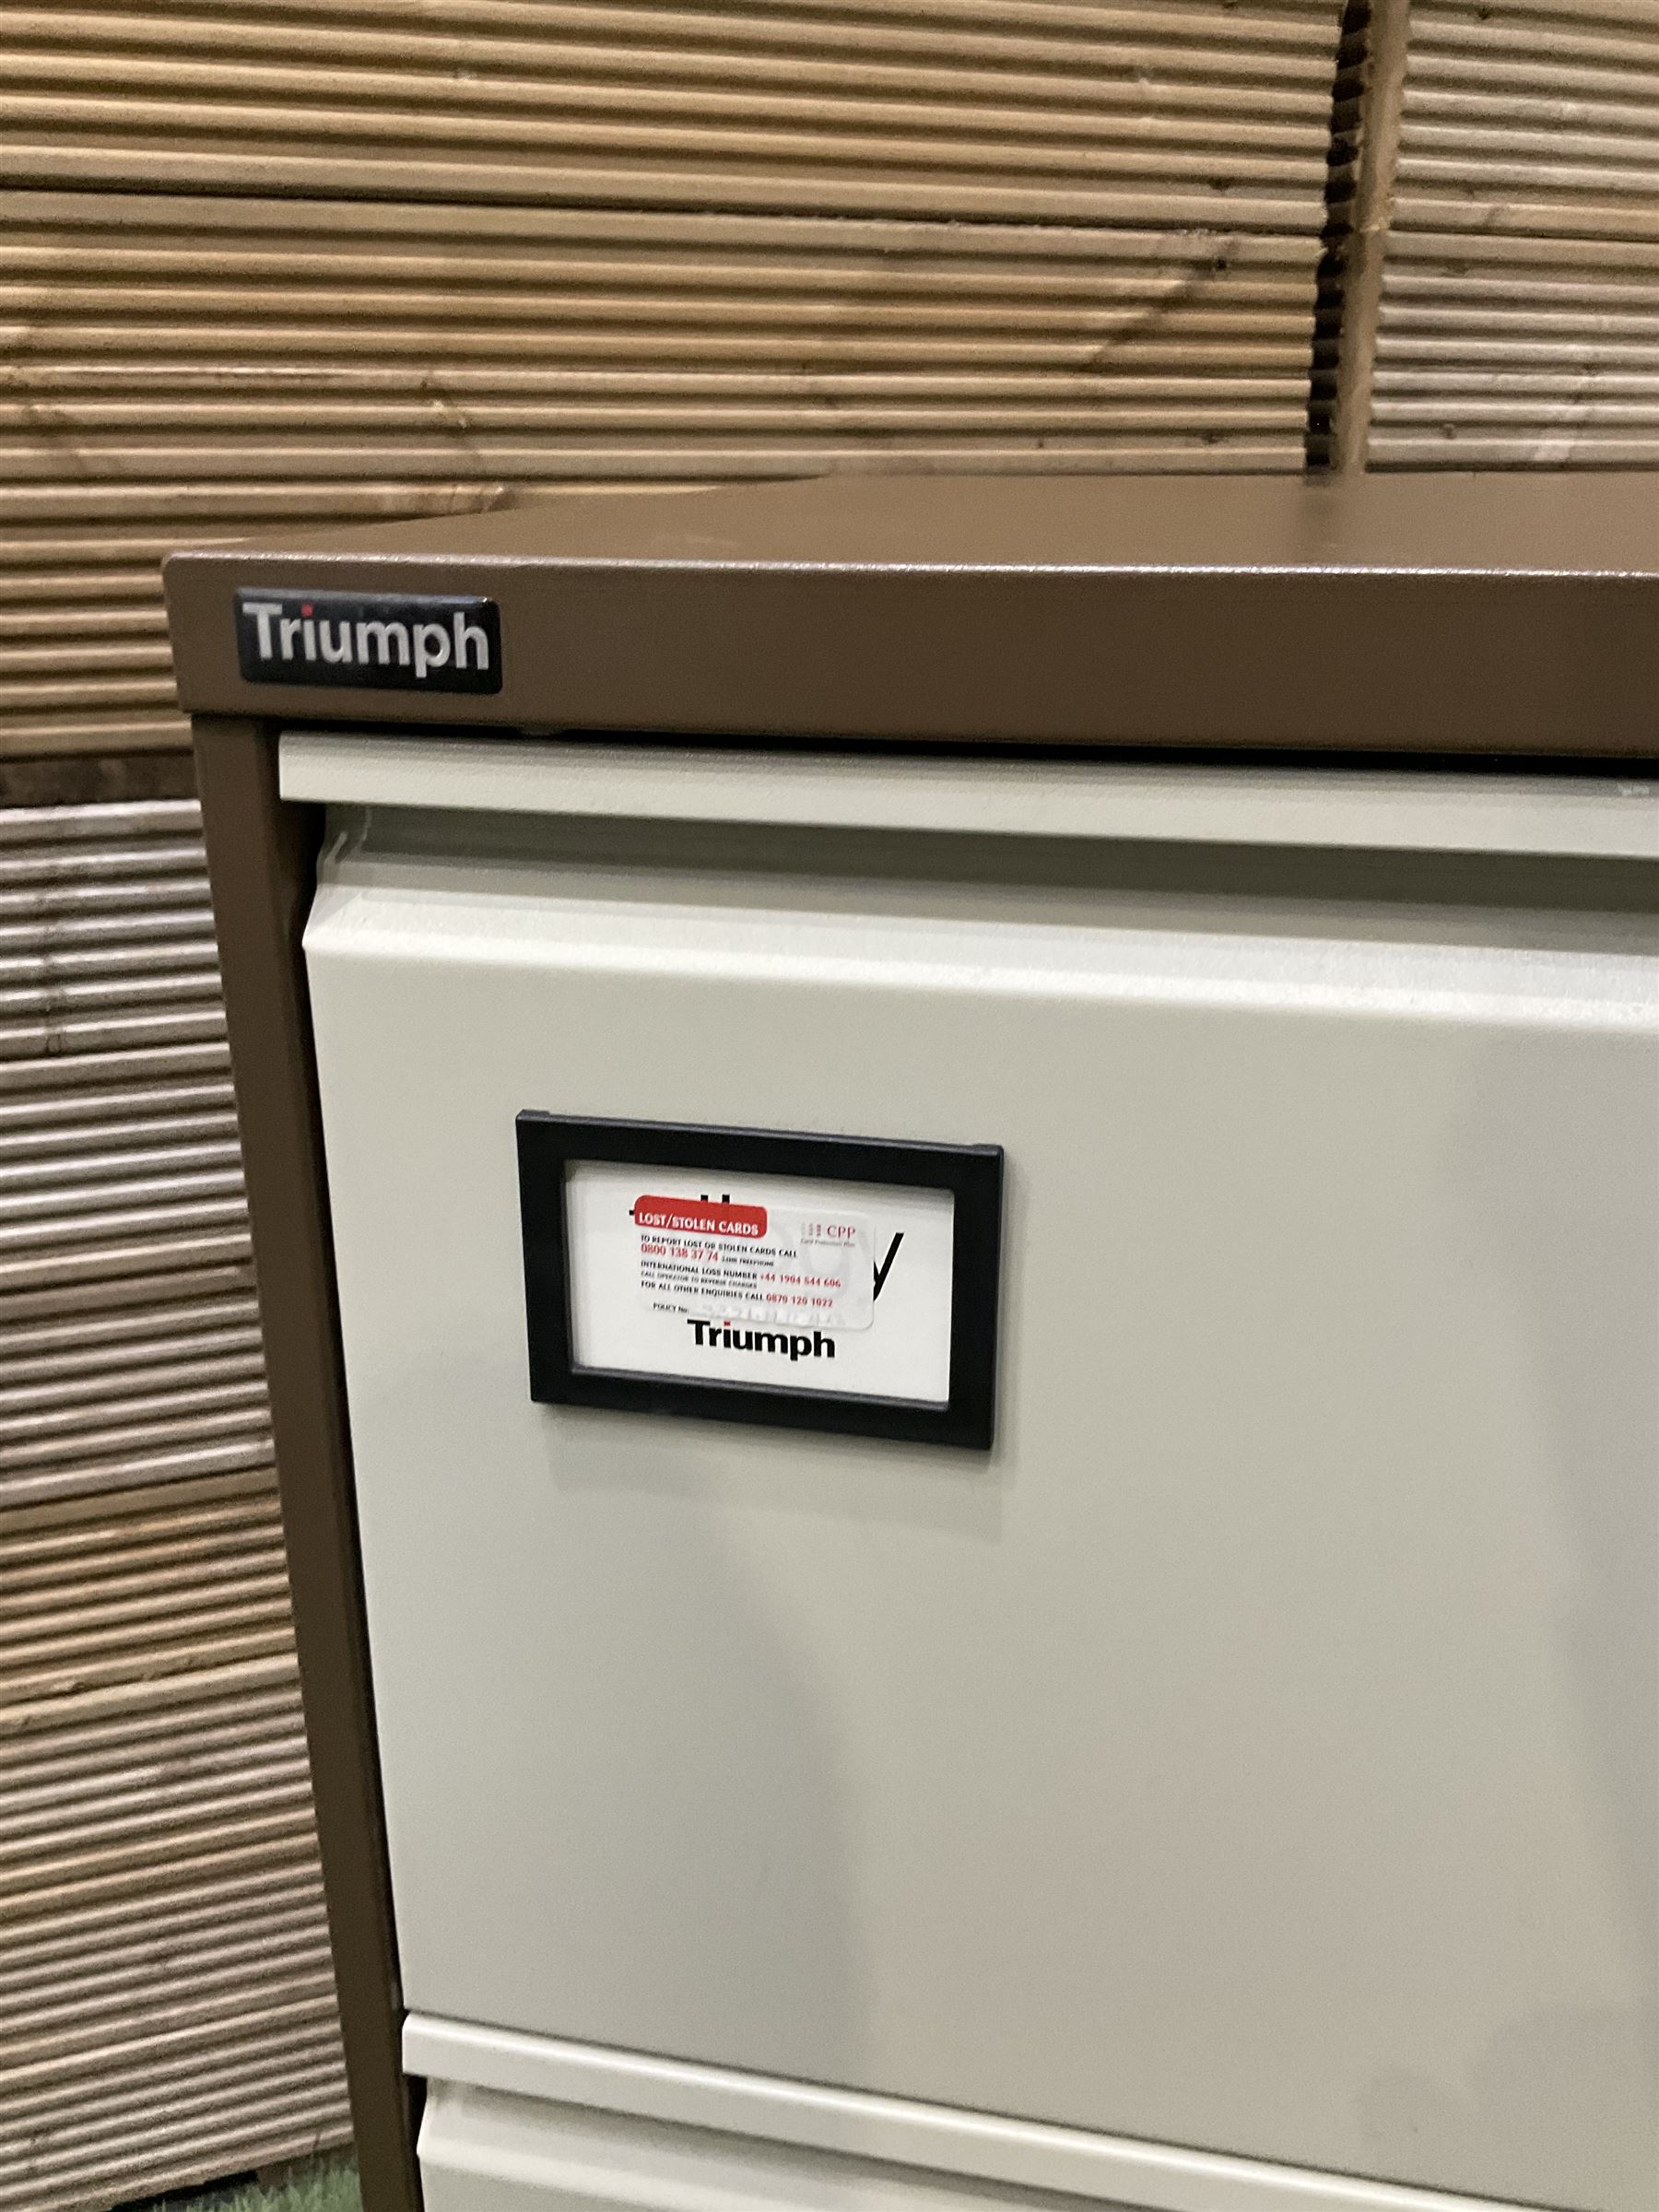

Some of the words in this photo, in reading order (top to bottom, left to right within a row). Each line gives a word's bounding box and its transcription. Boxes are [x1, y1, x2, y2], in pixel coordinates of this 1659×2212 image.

[241, 602, 489, 678] Triumph
[639, 1212, 715, 1231] LOST/STOLEN
[718, 1220, 759, 1236] CARDS
[827, 1224, 855, 1239] CPP
[641, 1234, 650, 1242] TO
[652, 1236, 681, 1246] REPORT
[684, 1240, 701, 1249] LOST
[704, 1241, 715, 1250] OR
[718, 1242, 747, 1253] STOLEN
[749, 1247, 776, 1256] CARDS
[779, 1249, 796, 1258] CALL
[641, 1244, 666, 1255] 0800
[670, 1248, 688, 1260] 138
[691, 1250, 703, 1261] 37
[707, 1252, 719, 1263] 74
[641, 1260, 699, 1275] INTERNATIONAL
[701, 1266, 721, 1277] LOSS
[723, 1269, 758, 1280] NUMBER
[760, 1272, 775, 1282] +44
[780, 1274, 801, 1285] 1904
[641, 1270, 655, 1278] CALL
[656, 1272, 688, 1283] OPERATOR
[700, 1277, 726, 1287] REVERSE
[728, 1279, 758, 1289] CHARGES
[641, 1280, 656, 1289] FOR
[658, 1283, 672, 1292] ALL
[674, 1285, 699, 1294] OTHER
[701, 1288, 743, 1300] ENQUIRIES
[746, 1291, 763, 1301] CALL
[766, 1293, 788, 1305] 0870
[792, 1295, 808, 1307] 120
[653, 1302, 677, 1312] POLICY
[687, 1318, 835, 1361] Triumph
